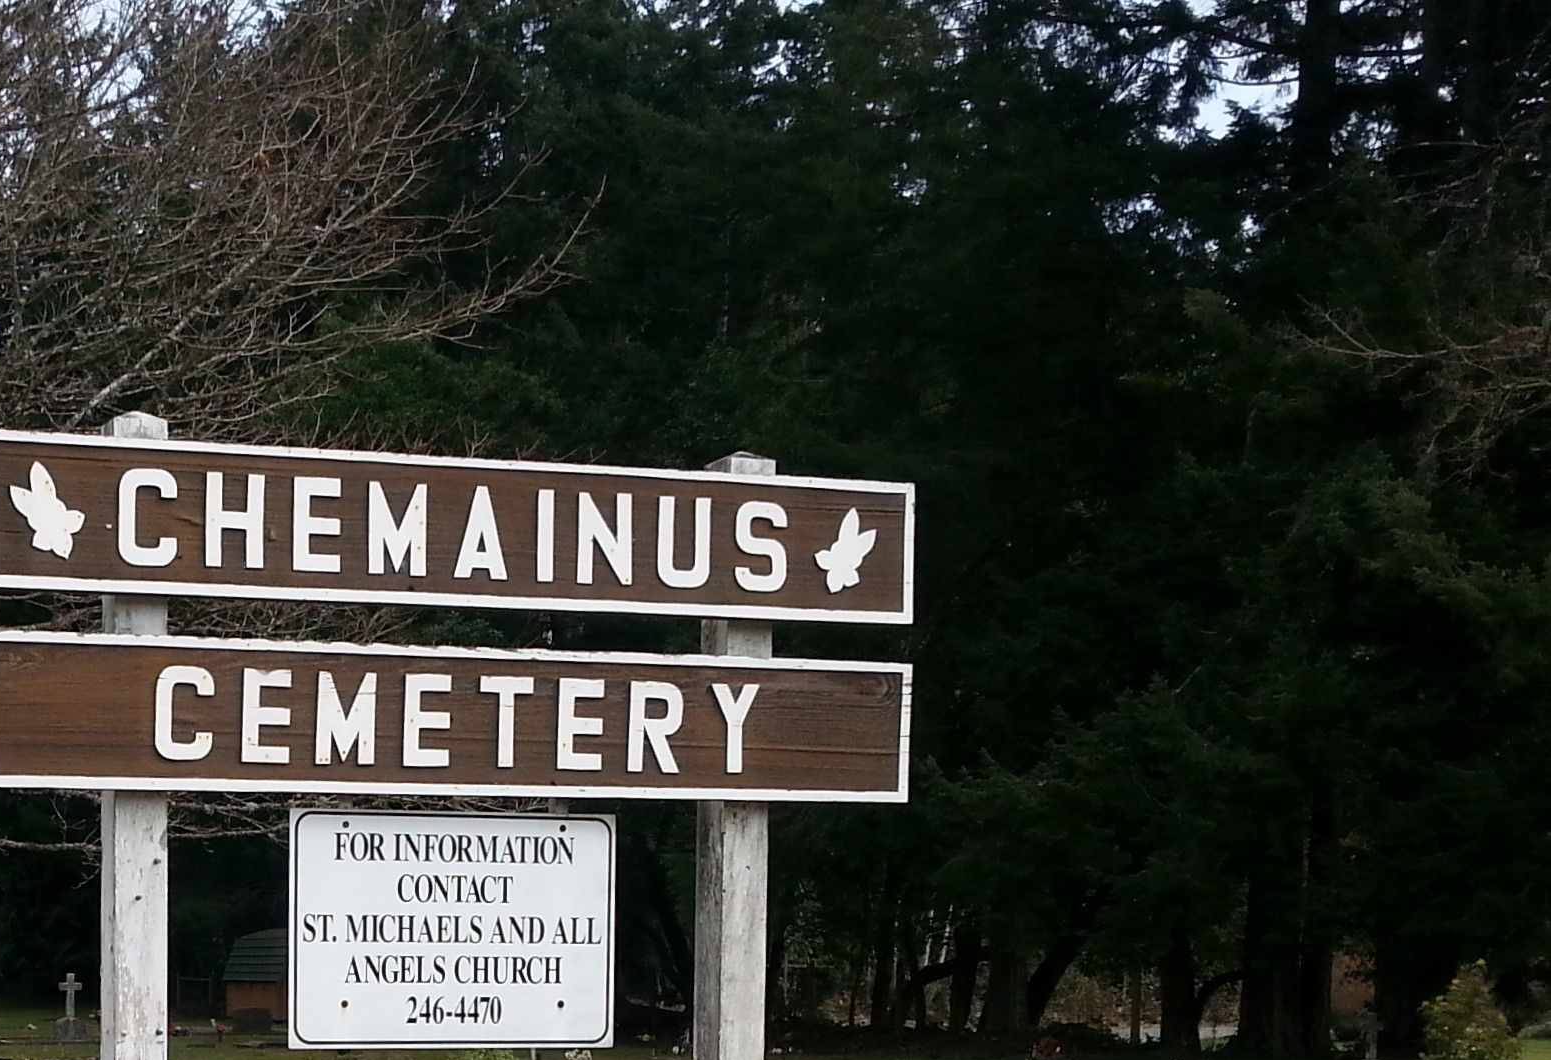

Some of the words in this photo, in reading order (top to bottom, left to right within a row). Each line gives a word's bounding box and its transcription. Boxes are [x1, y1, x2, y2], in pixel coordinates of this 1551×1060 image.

[117, 468, 789, 592] CHEMAINUS
[154, 665, 759, 775] CEMETERY
[334, 832, 385, 861] FOR
[394, 833, 574, 865] INFORMATION
[397, 874, 513, 903] CONTACT
[302, 914, 337, 943] ST.
[345, 914, 482, 944] MICHAELS
[490, 916, 545, 944] AND
[553, 917, 602, 945] ALL
[344, 955, 446, 984] ANGELS
[454, 956, 562, 984] CHURCH
[405, 996, 501, 1025] 246-4470
